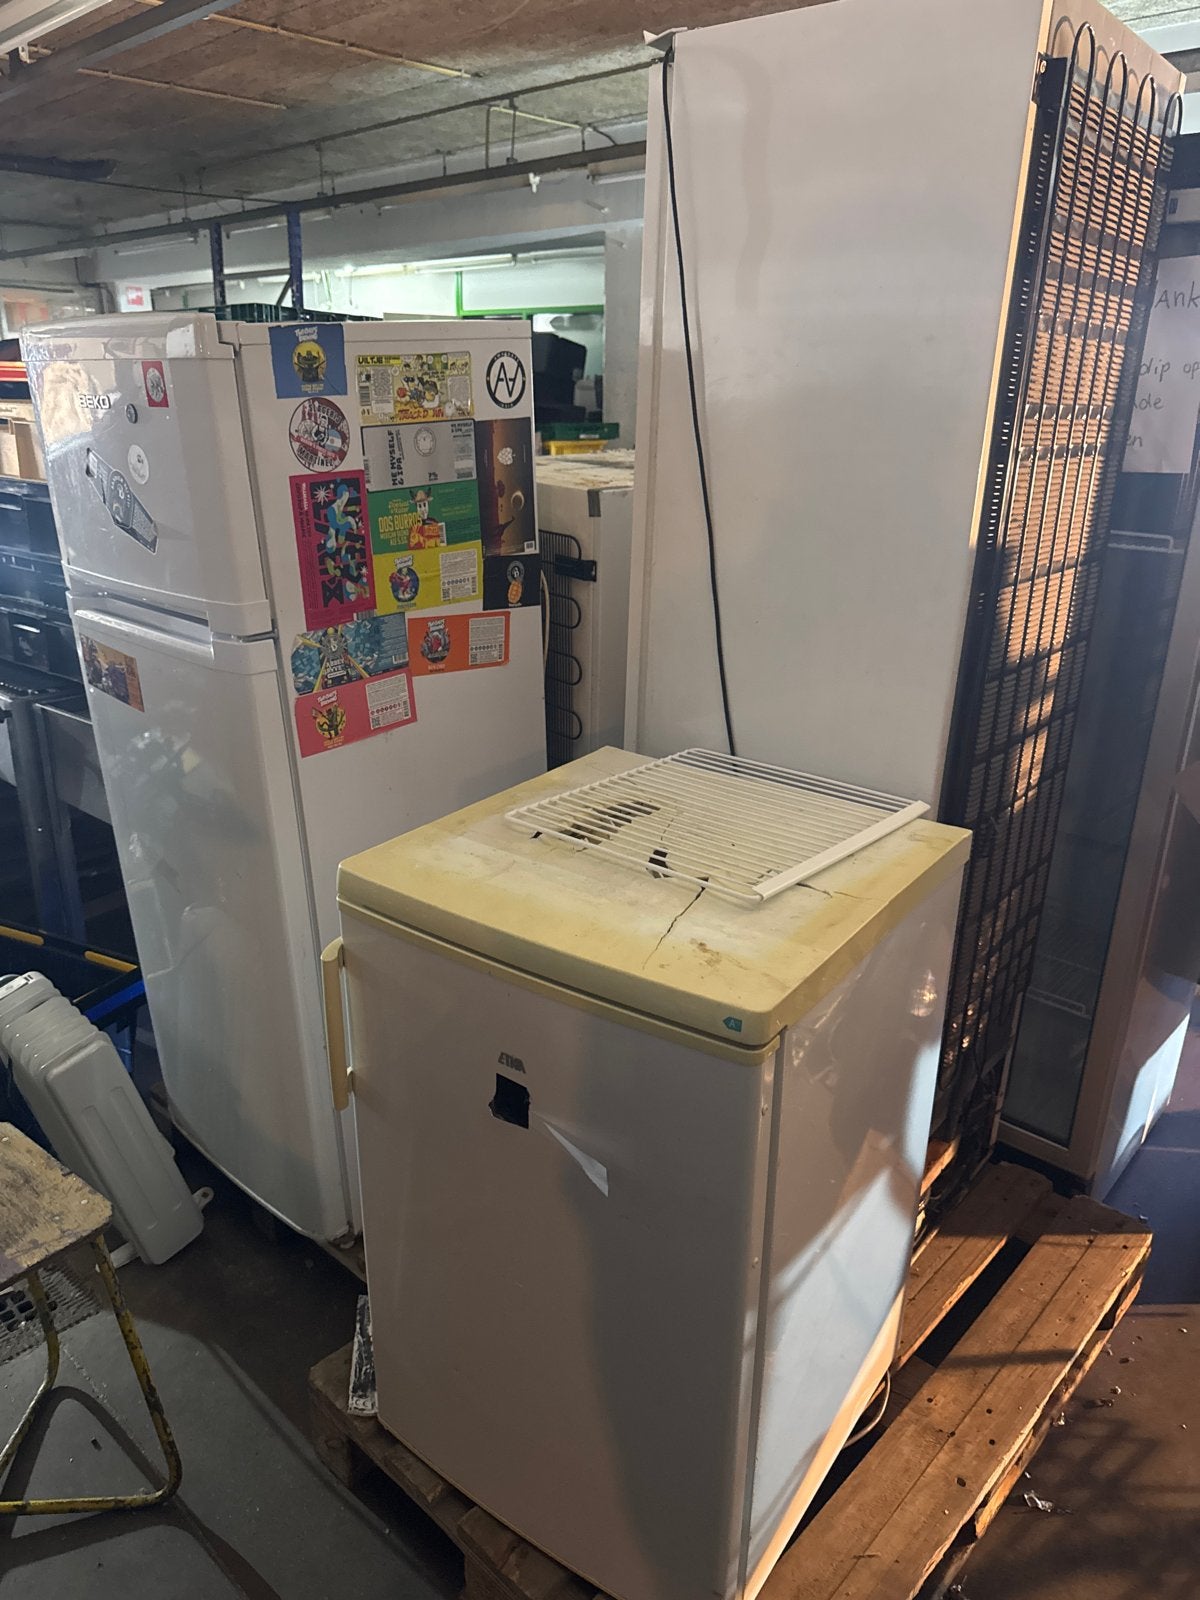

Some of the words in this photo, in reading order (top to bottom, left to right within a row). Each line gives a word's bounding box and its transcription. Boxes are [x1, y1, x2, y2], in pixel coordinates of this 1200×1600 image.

[79, 394, 111, 410] BEKO
[387, 430, 396, 470] MYSELF
[396, 457, 404, 476] IPA
[391, 472, 398, 486] ME
[378, 515, 394, 533] DOS
[394, 511, 423, 530] BURROS
[729, 1019, 736, 1027] A
